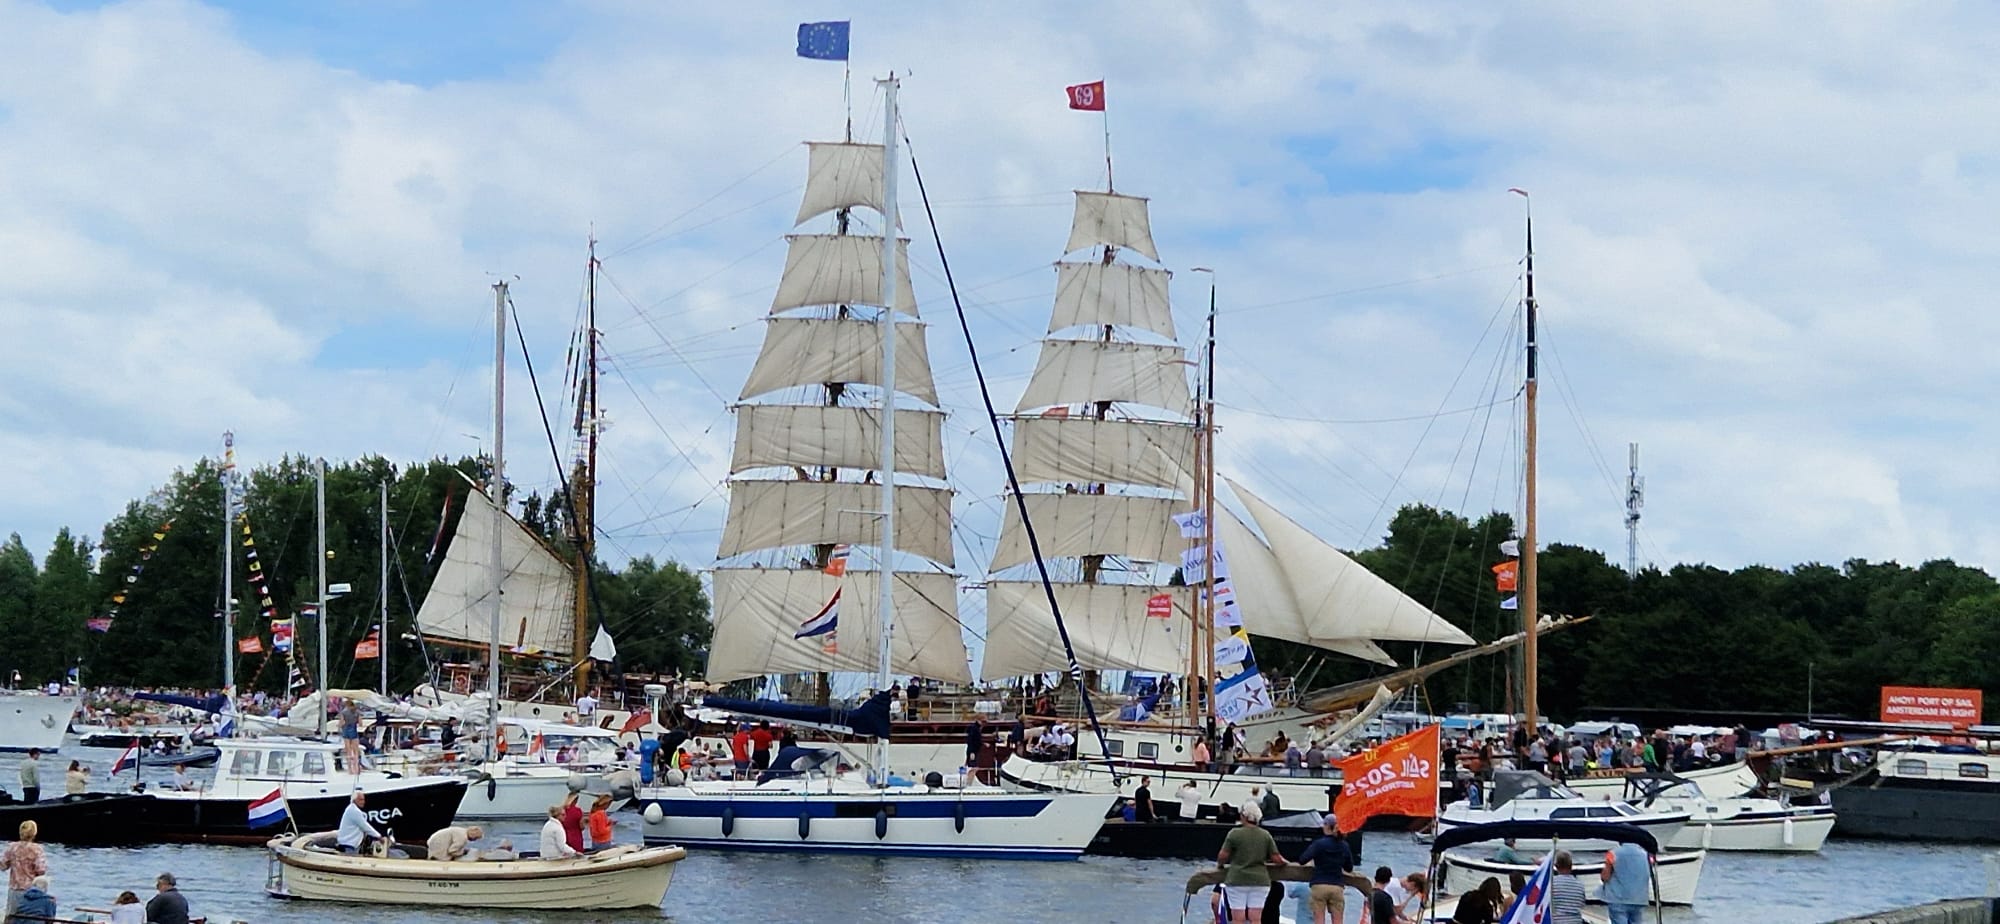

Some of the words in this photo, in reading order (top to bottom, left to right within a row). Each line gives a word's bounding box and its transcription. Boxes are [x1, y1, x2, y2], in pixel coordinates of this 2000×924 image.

[1917, 697, 1940, 706] PORT
[1941, 698, 1954, 707] OF
[1955, 699, 1974, 708] SAIL
[1886, 706, 1938, 716] AMSTERDAM
[1939, 708, 1950, 716] IN
[1951, 709, 1976, 718] SIGHT
